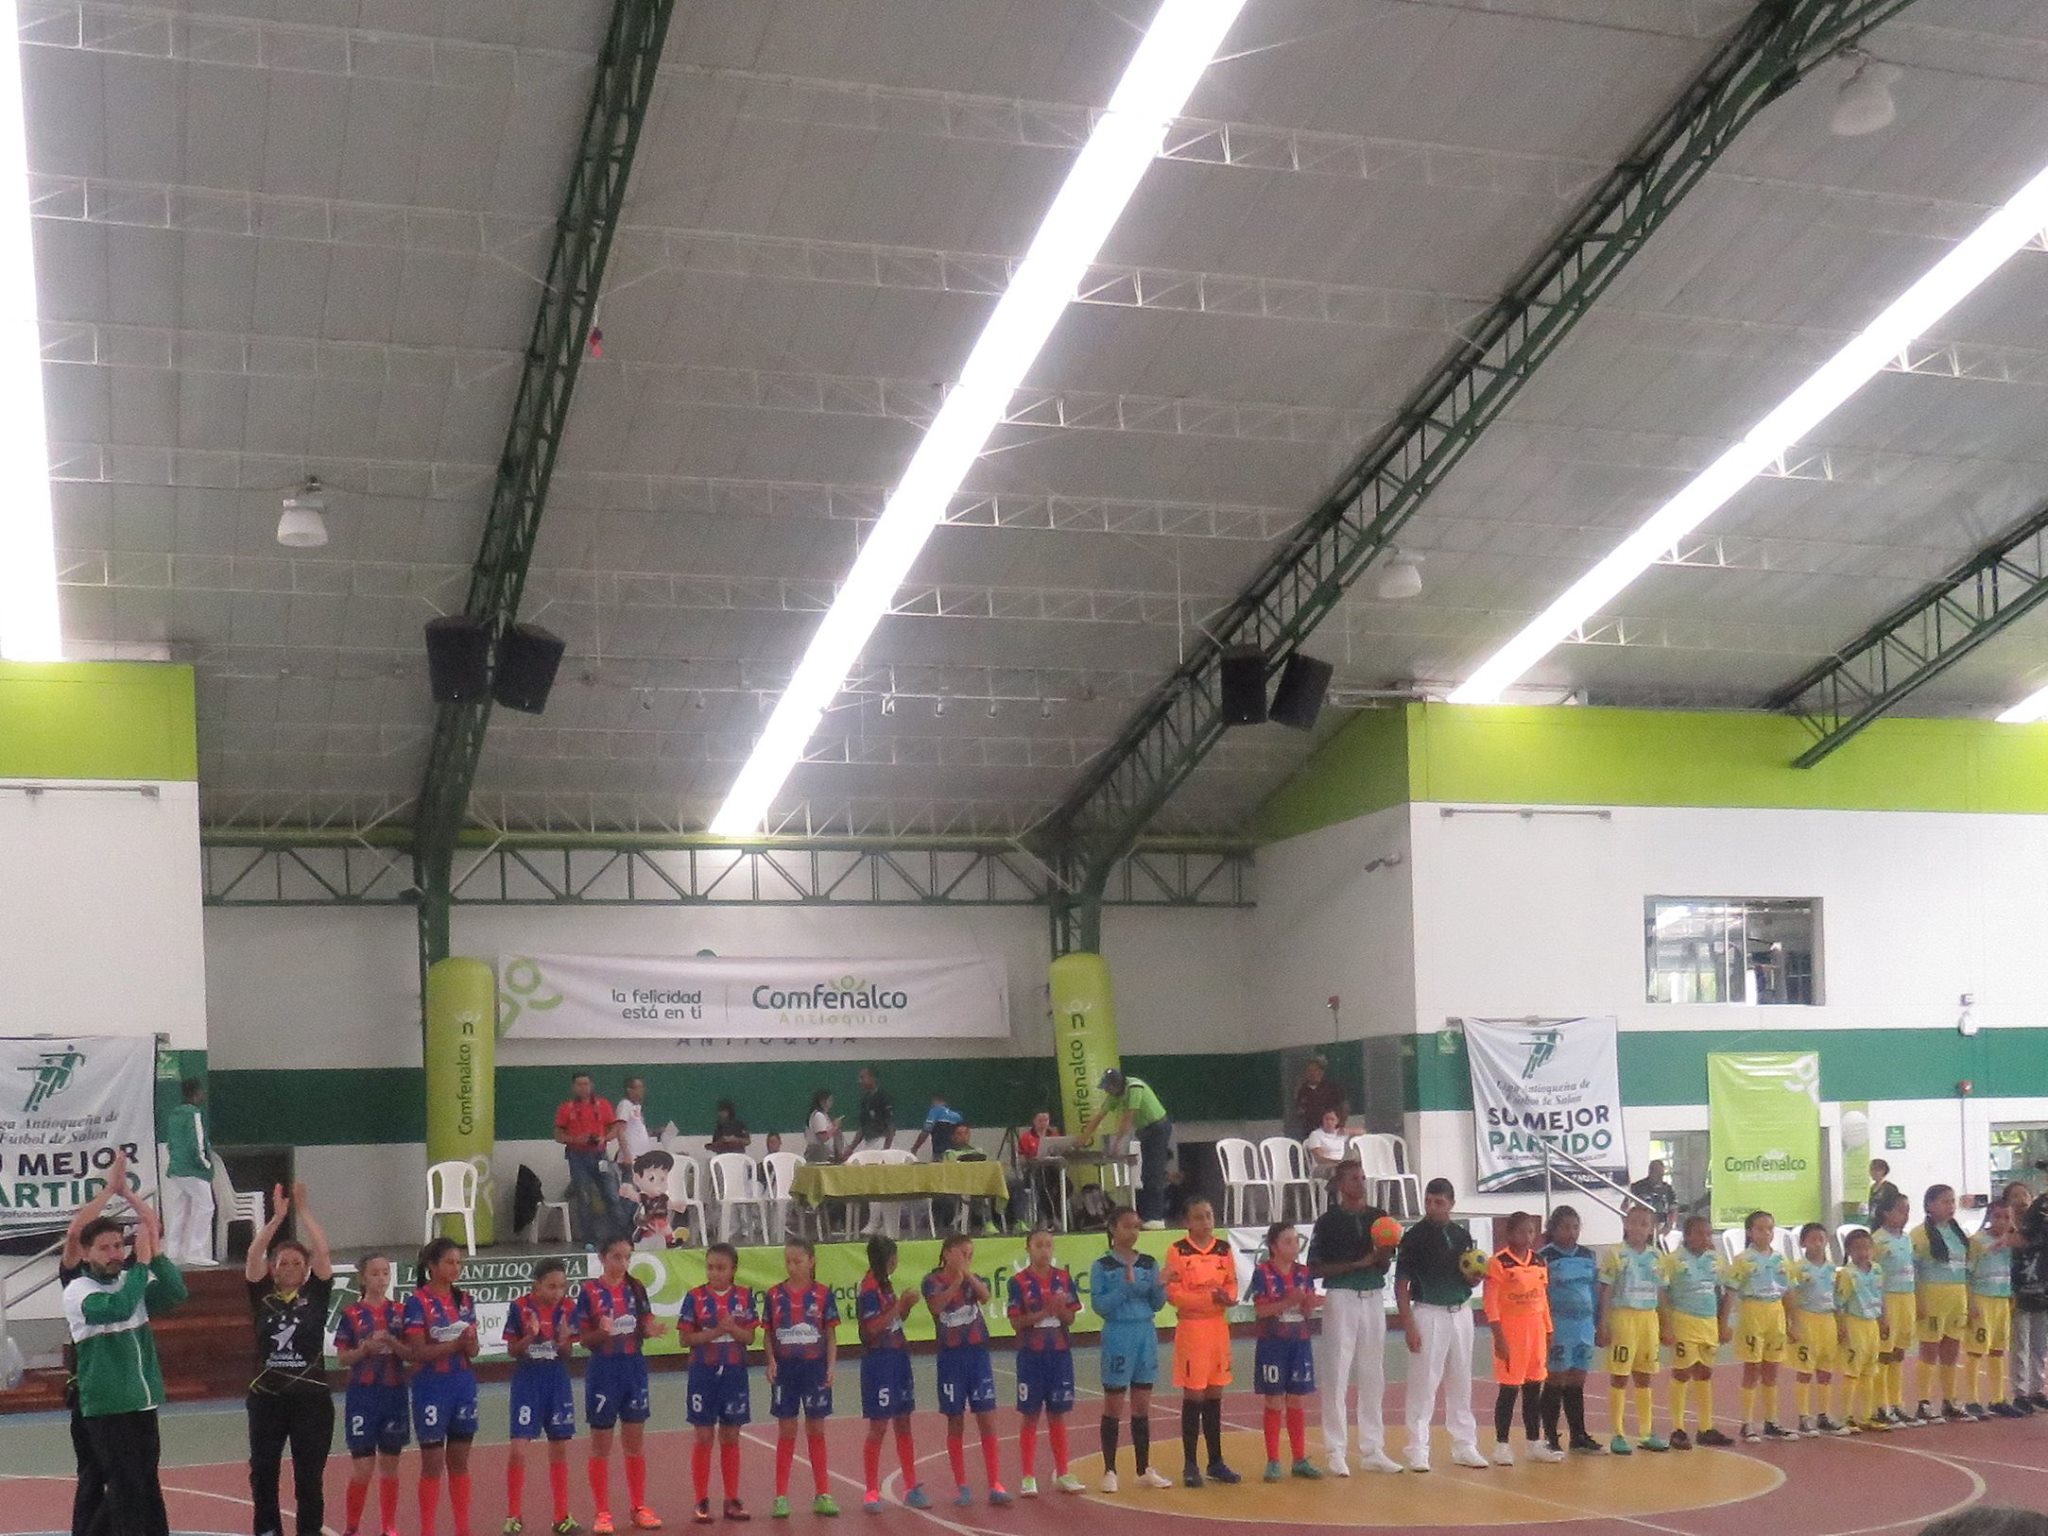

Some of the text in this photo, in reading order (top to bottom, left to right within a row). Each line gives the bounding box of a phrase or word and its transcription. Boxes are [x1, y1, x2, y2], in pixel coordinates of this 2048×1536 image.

[612, 988, 702, 1004] la felicidad
[751, 984, 908, 1010] Comfenalco
[622, 1005, 659, 1020] está
[664, 1008, 685, 1020] en
[778, 1011, 888, 1026] Antioquia
[456, 1043, 473, 1136] Comfenalco
[1488, 1104, 1610, 1133] SU MEJOR
[49, 1131, 67, 1145] de
[1487, 1128, 1612, 1155] PARTIDO
[18, 1142, 140, 1180] MEJOR
[1724, 1154, 1807, 1173] Comfenalco
[1745, 1336, 1756, 1351] 4
[1976, 1328, 1986, 1344] 8
[1613, 1345, 1629, 1363] 10
[1110, 1355, 1126, 1374] 12
[1262, 1364, 1279, 1384] 10
[774, 1385, 782, 1405] 1
[878, 1387, 890, 1407] 5
[943, 1383, 955, 1403] 4
[1018, 1382, 1028, 1402] 9
[595, 1394, 607, 1414] 7
[352, 1415, 364, 1436] 2
[425, 1405, 438, 1427] 3
[518, 1405, 531, 1426] 8
